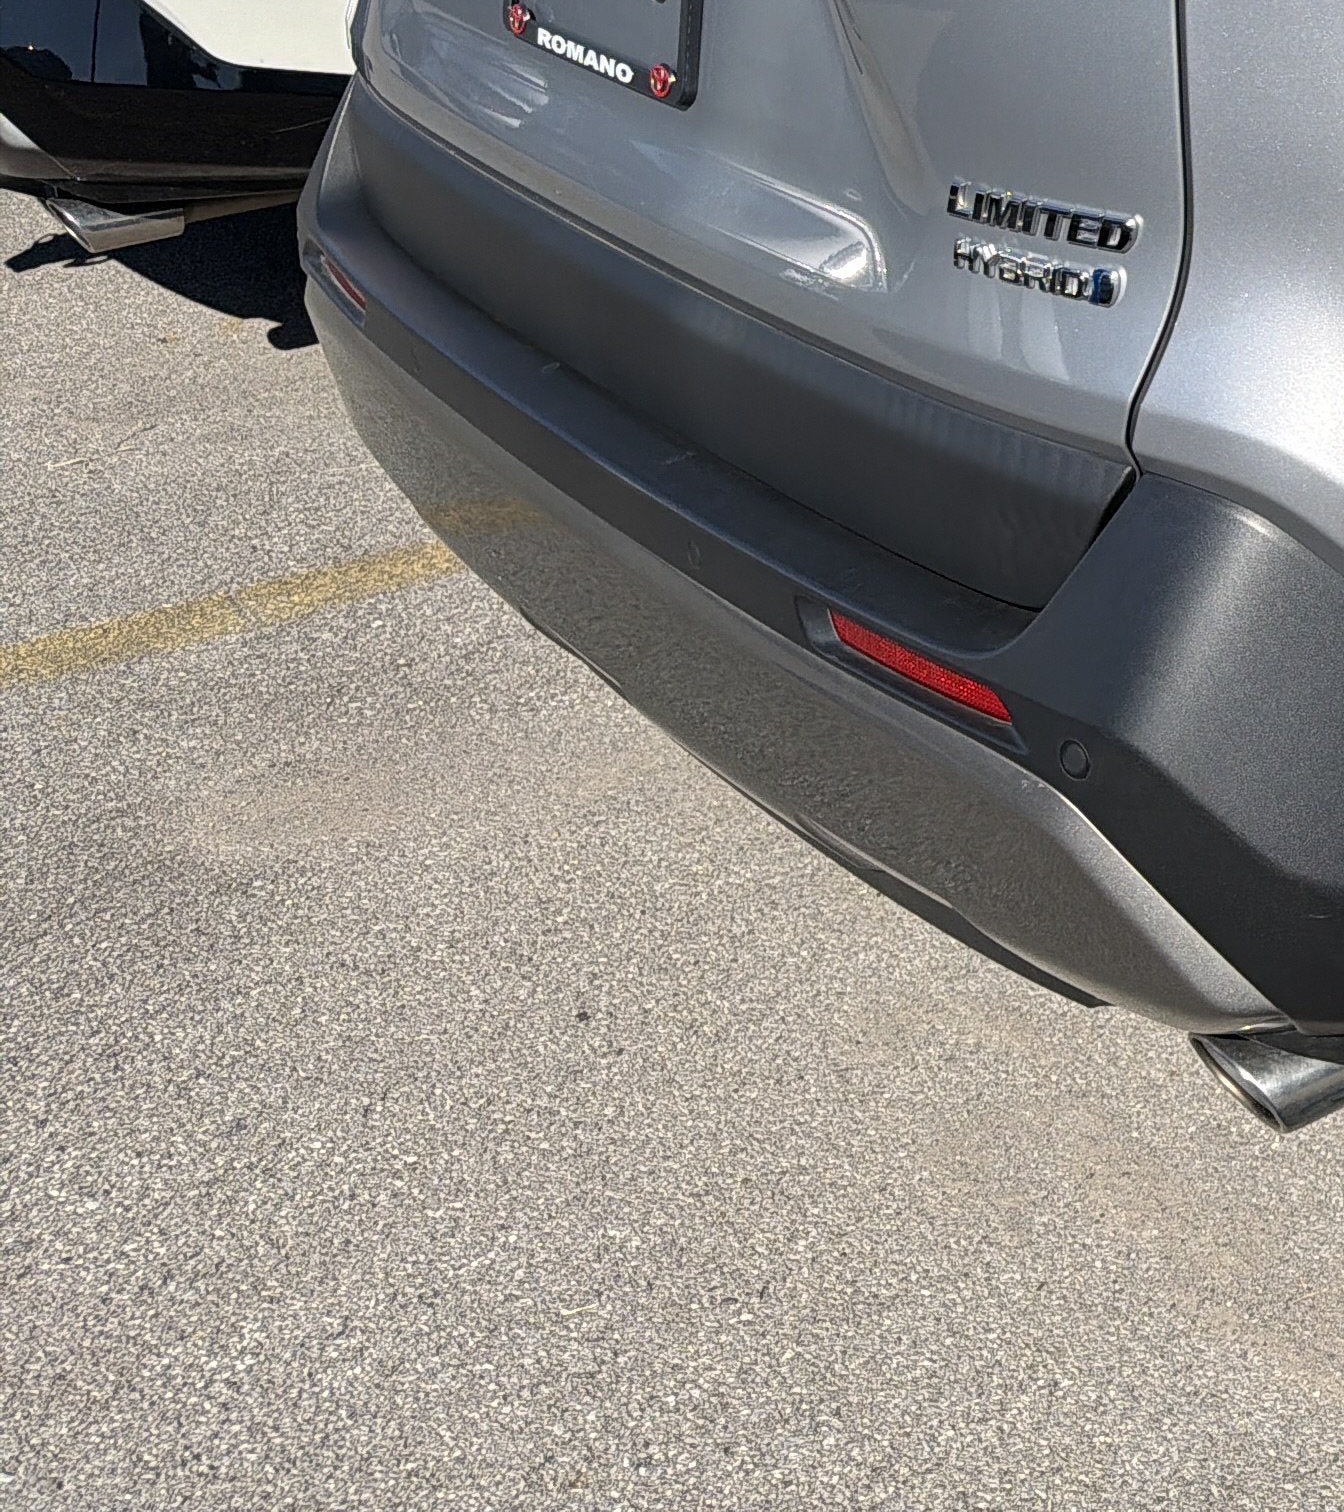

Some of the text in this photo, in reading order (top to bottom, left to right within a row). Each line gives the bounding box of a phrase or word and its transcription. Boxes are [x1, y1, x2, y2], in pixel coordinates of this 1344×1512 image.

[537, 27, 634, 84] ROMANO
[947, 178, 1142, 254] LIMITED
[953, 235, 1091, 300] HYBRID
